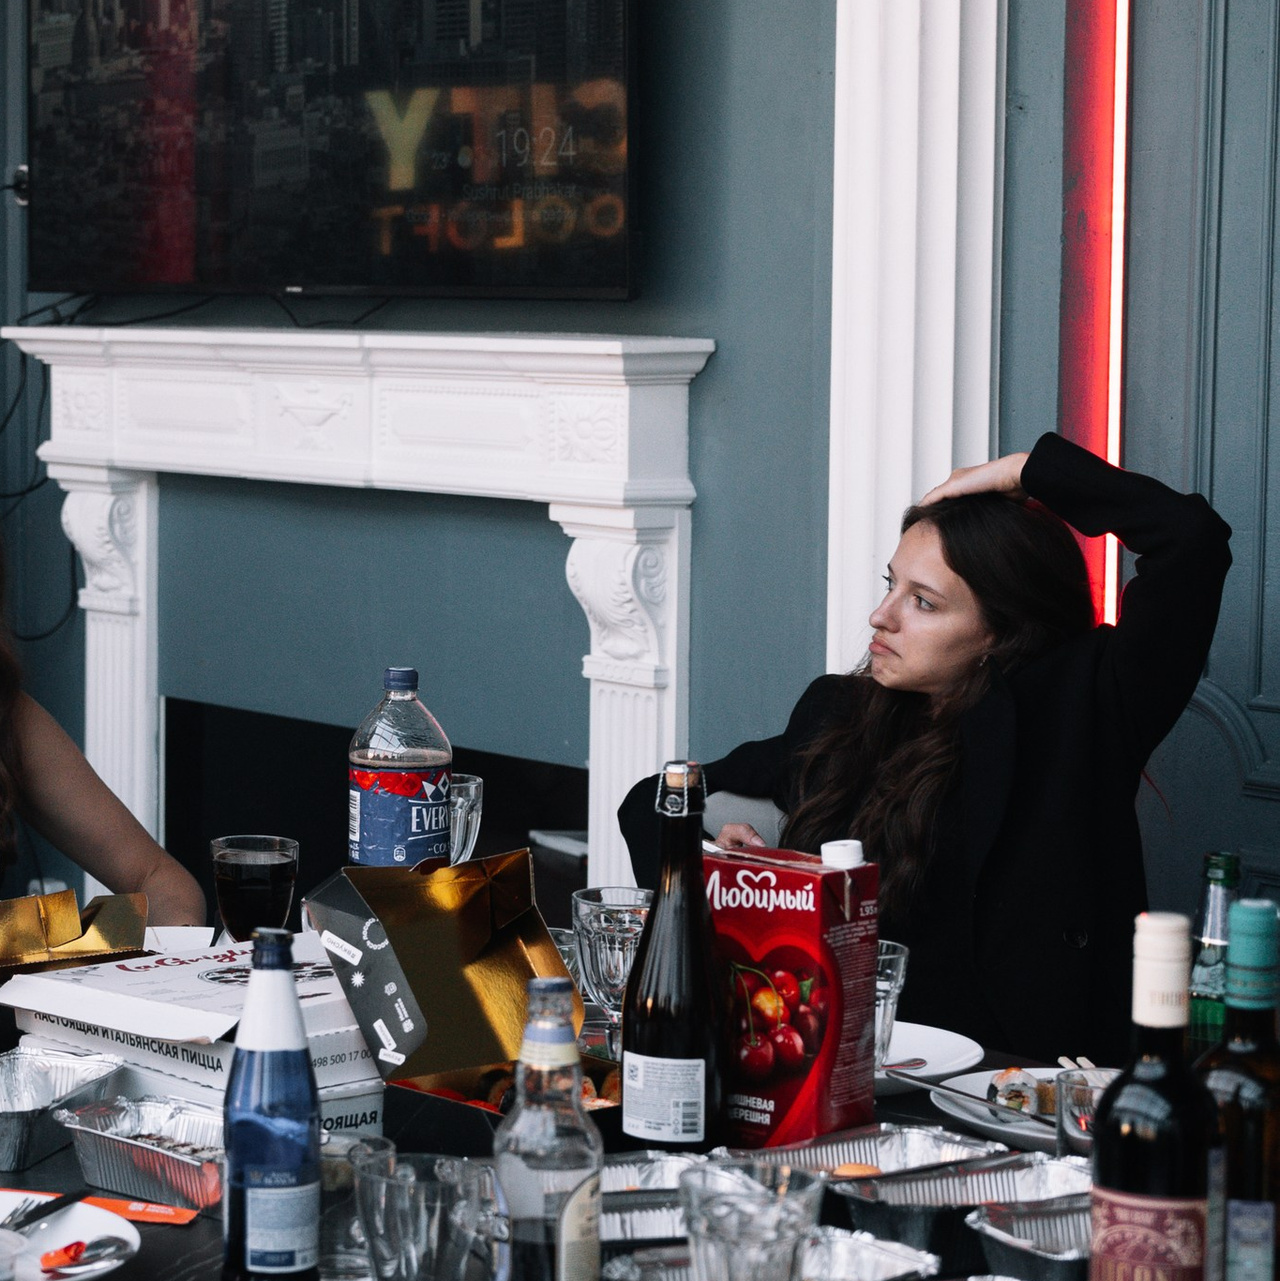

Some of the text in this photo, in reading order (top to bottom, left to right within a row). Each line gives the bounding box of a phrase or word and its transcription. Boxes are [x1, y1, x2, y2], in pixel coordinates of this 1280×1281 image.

[496, 126, 577, 167] 19:24
[706, 869, 817, 913] Любимый
[101, 1026, 180, 1060] ИТАЛЬЯНСКАЯ
[181, 1047, 225, 1073] ПИЦЦА
[330, 1052, 347, 1066] 500
[349, 1050, 360, 1062] 17
